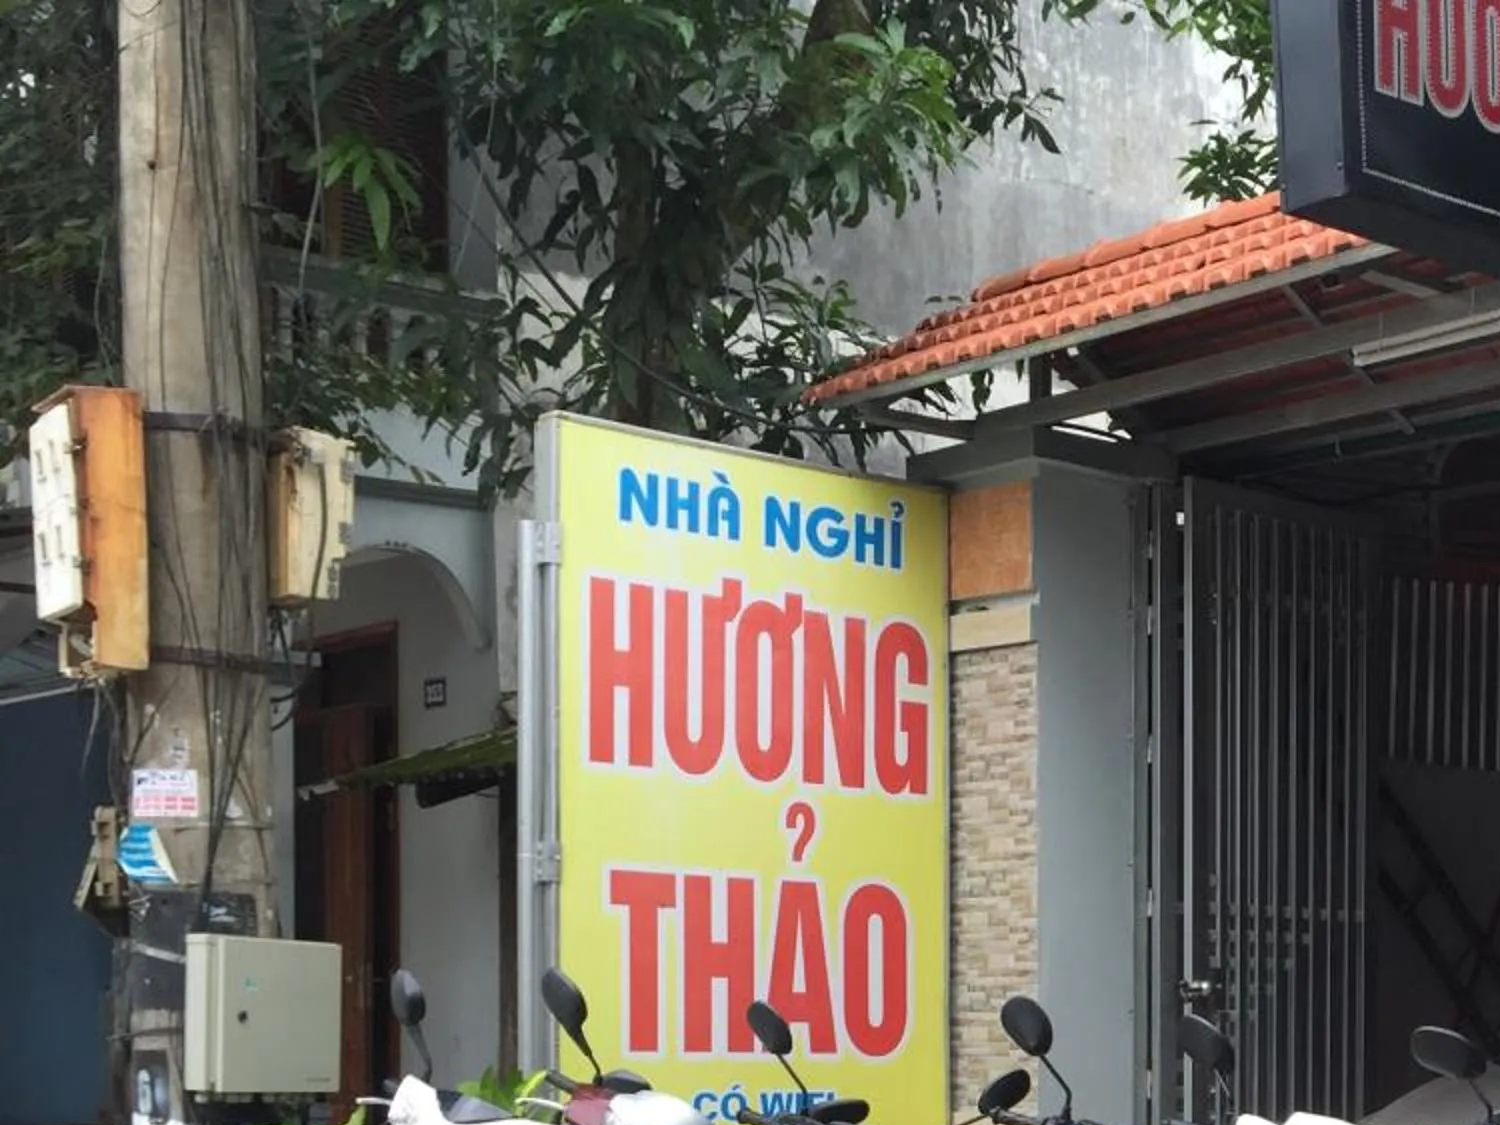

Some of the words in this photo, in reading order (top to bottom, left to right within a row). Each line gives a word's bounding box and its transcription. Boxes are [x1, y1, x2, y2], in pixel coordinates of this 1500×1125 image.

[617, 467, 741, 542] NHÀ
[764, 496, 906, 570] NGHỈ
[588, 575, 929, 795] HƯƠNG
[609, 801, 907, 1057] THẢO
[693, 1084, 747, 1121] CÓ
